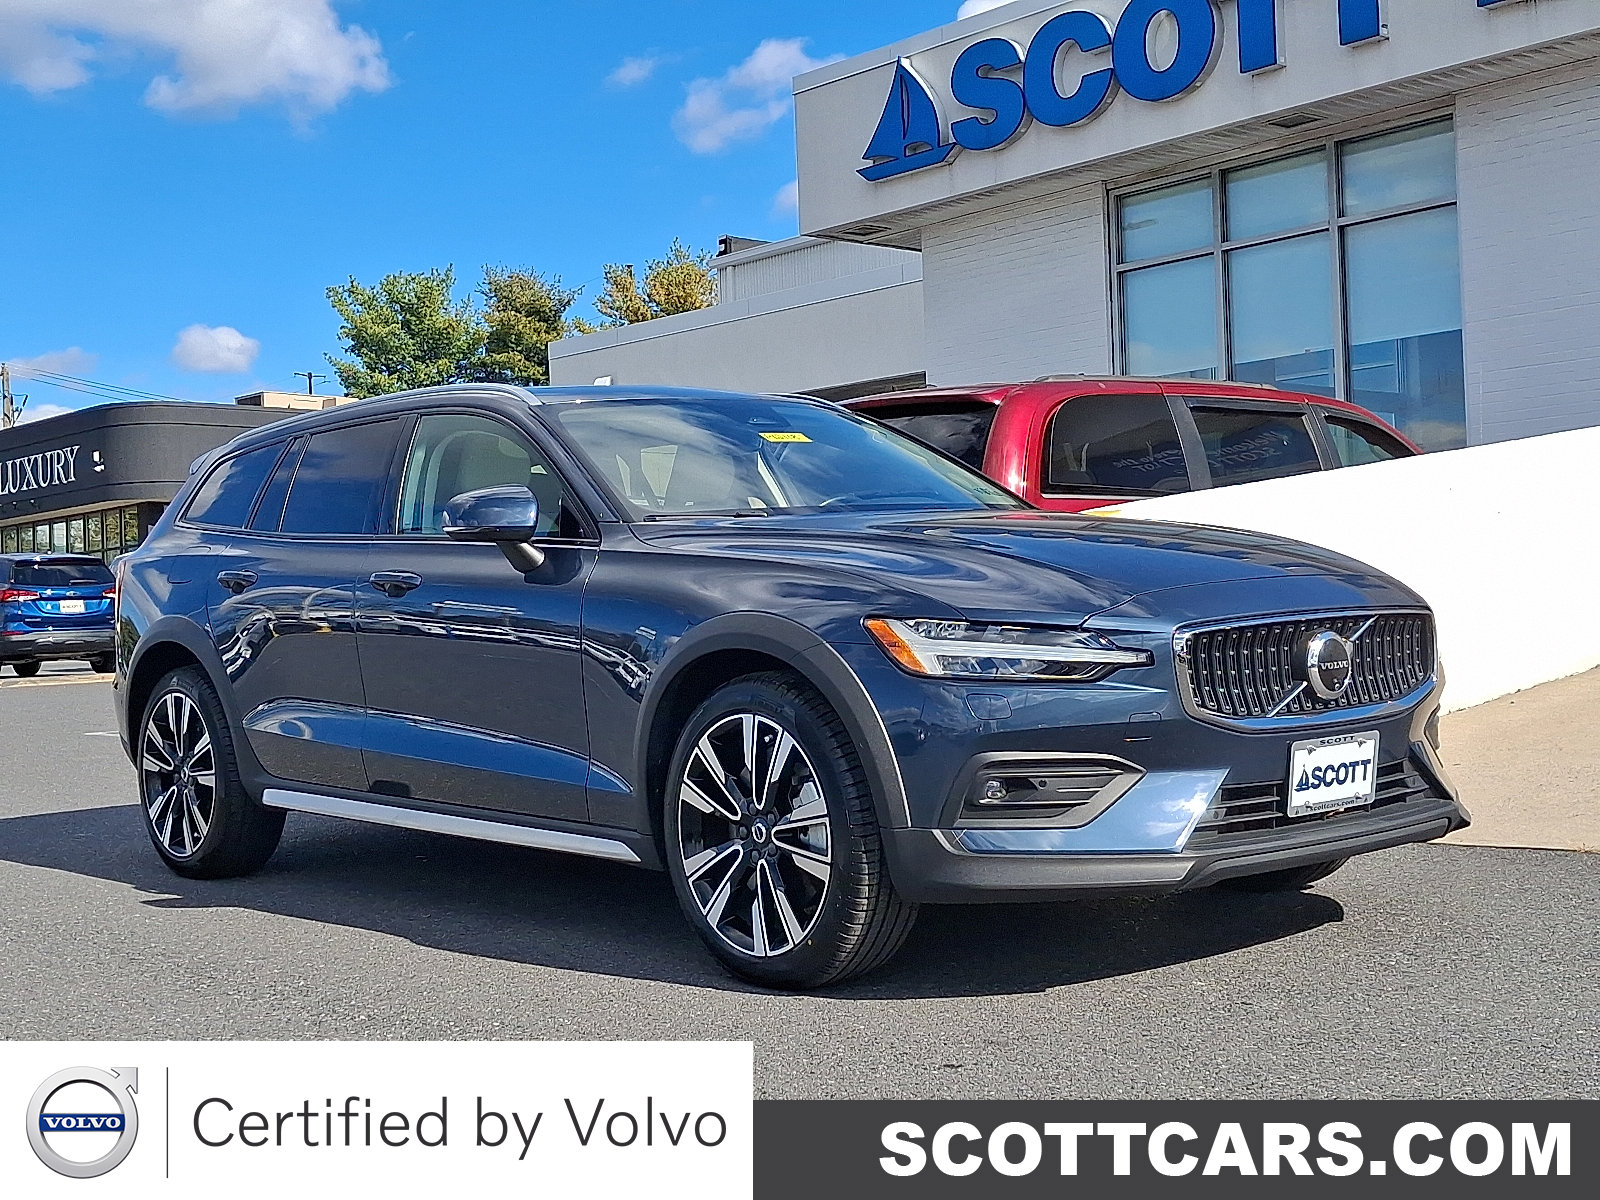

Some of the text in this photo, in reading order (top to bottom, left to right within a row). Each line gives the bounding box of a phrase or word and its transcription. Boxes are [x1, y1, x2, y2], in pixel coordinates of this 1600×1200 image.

[0, 445, 80, 495] LUXURY
[1319, 660, 1349, 670] VOLVO
[1319, 735, 1355, 746] SCOTT
[1311, 758, 1371, 790] SCOTT
